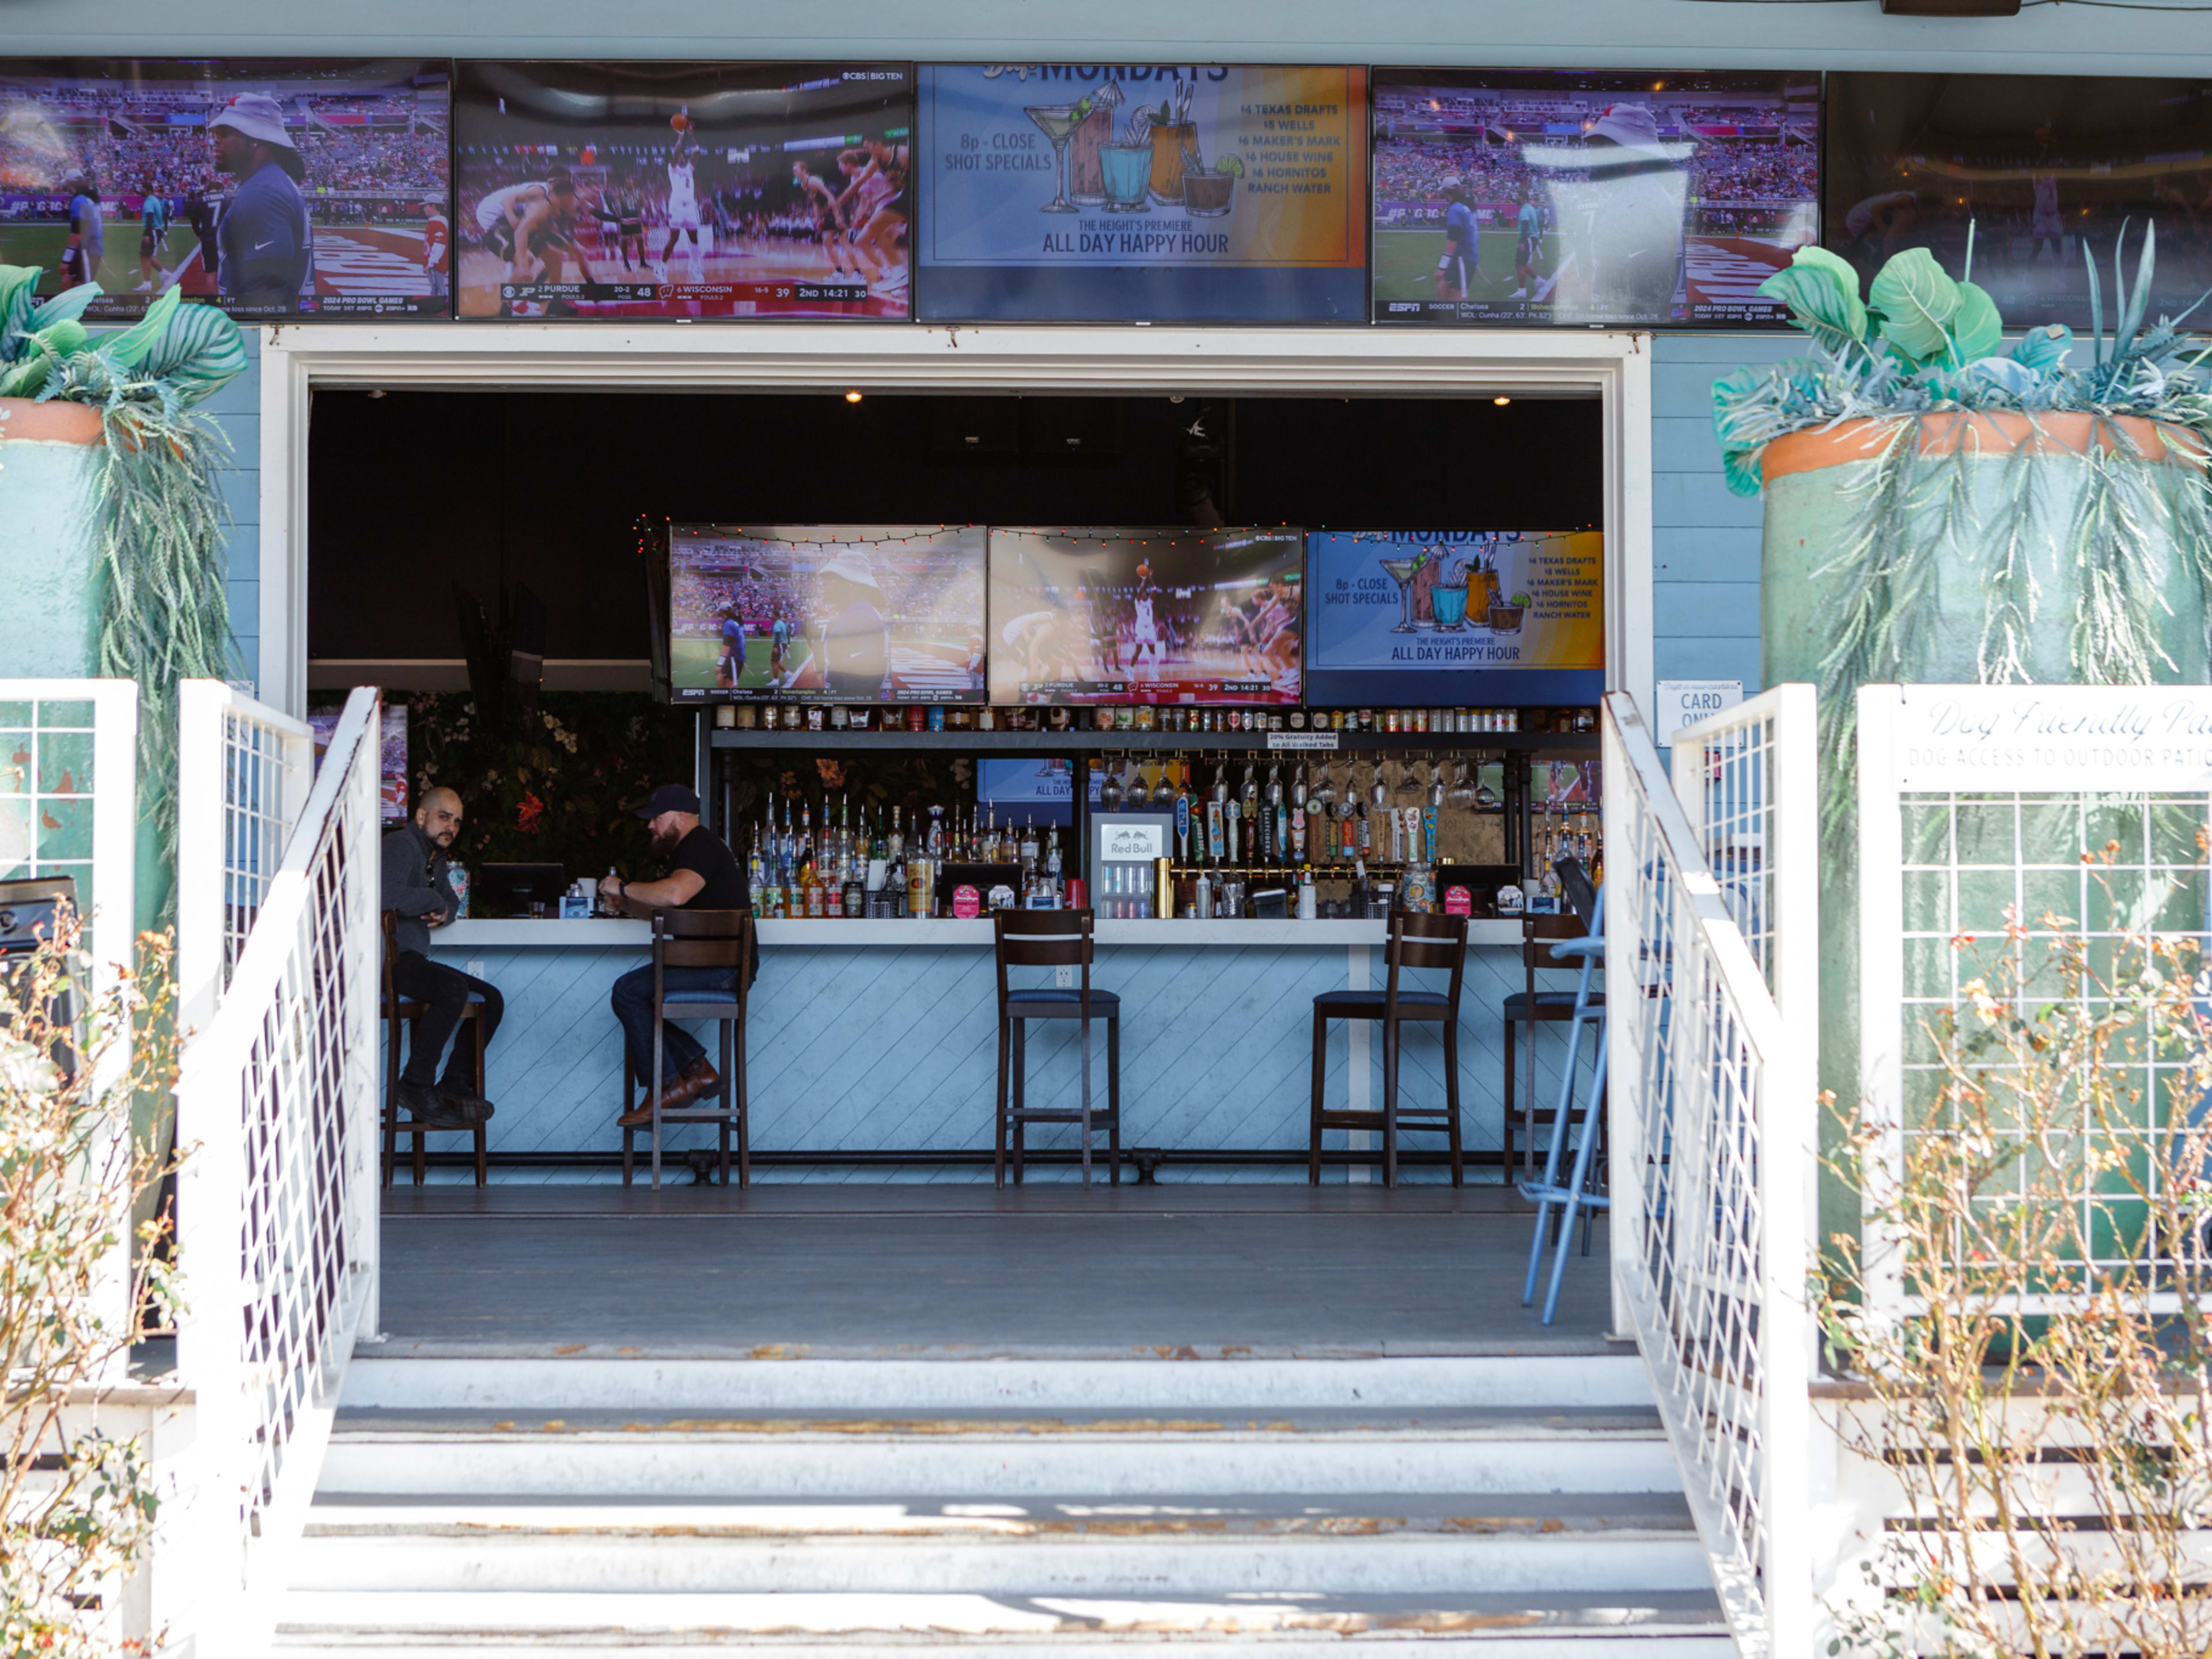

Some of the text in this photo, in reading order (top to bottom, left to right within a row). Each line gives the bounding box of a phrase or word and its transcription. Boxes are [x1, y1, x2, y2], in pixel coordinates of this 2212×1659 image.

[1255, 105, 1291, 114] TEXAS
[1296, 105, 1338, 114] DRAFTS
[1264, 120, 1315, 130] $5 WELLS
[961, 133, 1035, 152] 8p CLOSE
[1238, 136, 1340, 146] $6 MAKER'S MARK
[1246, 152, 1333, 162] $6 HOUSE WINE
[945, 154, 1051, 171] SHOT SPECIALS
[1268, 168, 1326, 177] HORNITOS
[1248, 184, 1331, 194] RANCH WATER
[207, 201, 221, 226] 7
[1079, 221, 1192, 231] THE HEIGHT'S PREMIERE
[1043, 234, 1228, 252] ALL DAY HAPPY HOUR
[637, 287, 651, 297] 48
[777, 289, 790, 297] 39
[800, 289, 819, 297] 2ND
[823, 289, 848, 297] 14:21
[1389, 303, 1420, 312] ESPN
[1336, 579, 1387, 591] 8p CLOSE
[1325, 593, 1398, 604] SHOT SPECIALS
[1416, 638, 1495, 646] THE HEIGHT'S PREMIERE
[1392, 647, 1520, 660] ALL DAY HAPPY HOUR
[1681, 693, 1722, 709] CARD
[1682, 713, 1715, 728] ON
[1930, 699, 2212, 743] Dog Friendly Pa
[1909, 749, 1946, 766] DOG
[1957, 749, 2024, 766] ACCESS
[2035, 749, 2055, 766] TO
[2065, 749, 2153, 766] OUTDOOR
[1036, 786, 1071, 796] ALL DAY
[1111, 843, 1152, 853] Red Bull
